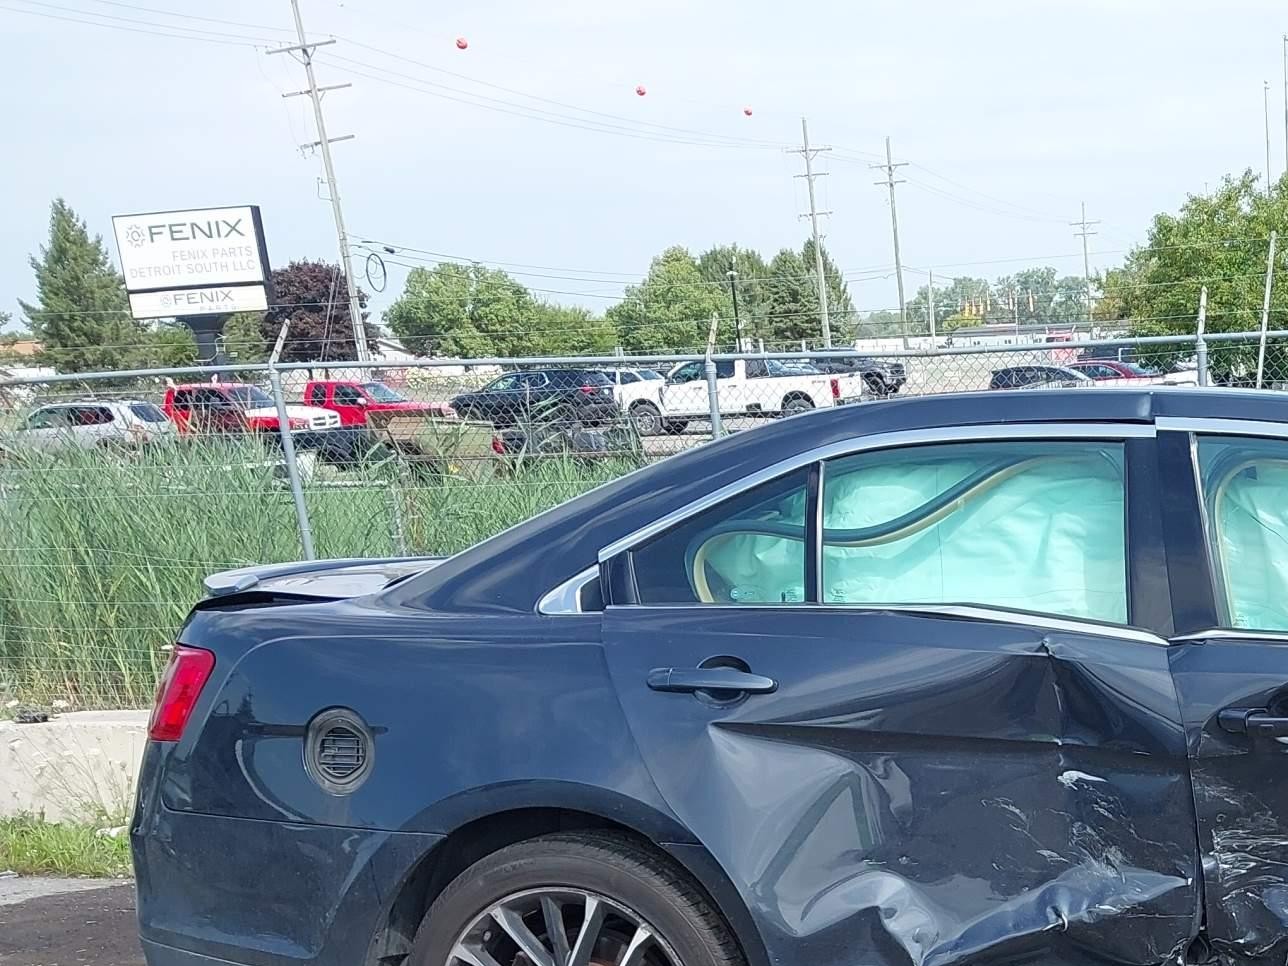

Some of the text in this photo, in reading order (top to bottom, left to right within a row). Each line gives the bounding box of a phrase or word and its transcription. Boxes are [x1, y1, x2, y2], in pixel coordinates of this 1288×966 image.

[148, 218, 245, 243] FENIX
[172, 246, 253, 262] FENIX PARTS
[129, 259, 256, 279] DETROIT SOUTH LLC
[173, 290, 235, 305] FENIX
